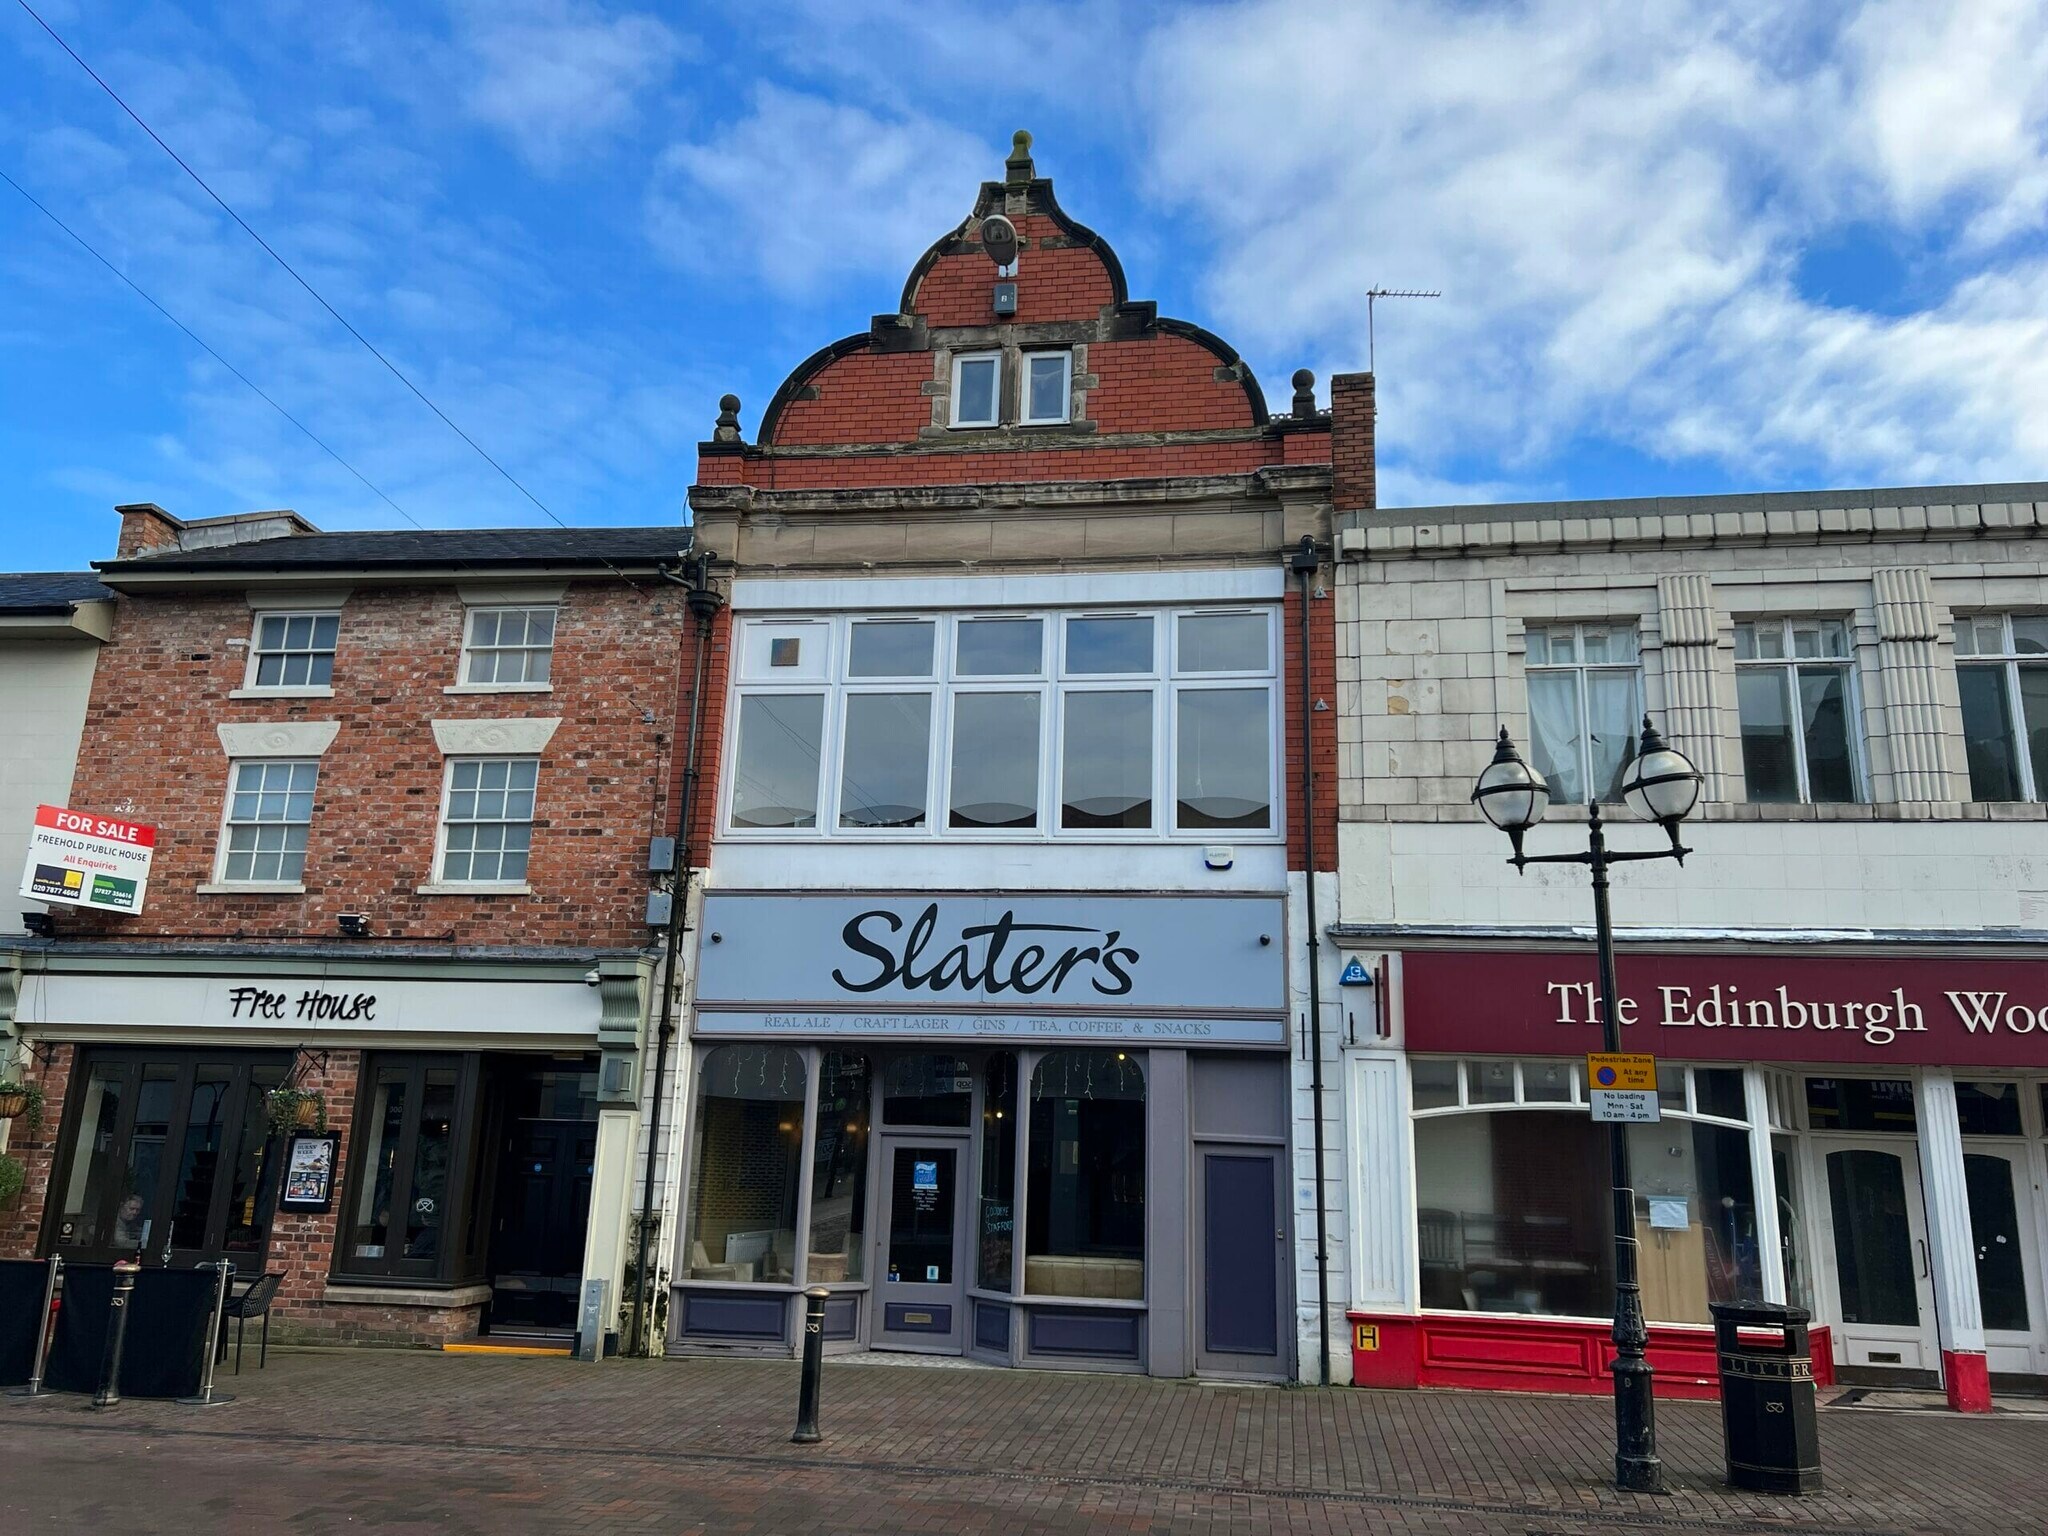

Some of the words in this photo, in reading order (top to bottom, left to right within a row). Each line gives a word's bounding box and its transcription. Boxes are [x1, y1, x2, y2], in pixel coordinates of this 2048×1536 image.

[56, 812, 92, 833] FOR
[96, 821, 139, 842] SALE
[37, 834, 84, 851] FREEHOLD
[85, 843, 117, 857] PUBLIC
[118, 850, 147, 862] HOUSE
[63, 854, 76, 863] All
[77, 857, 118, 871] Enquiries
[33, 884, 45, 893] 020
[831, 902, 1140, 996] Slater's
[229, 987, 287, 1019] Free
[296, 989, 377, 1021] House
[1657, 984, 1929, 1046] Edinburgh
[764, 1015, 800, 1028] REAL
[804, 1016, 831, 1028] ALE
[853, 1016, 900, 1029] CRAFT
[903, 1017, 949, 1030] LAGER
[972, 1018, 1005, 1031] GINS
[1068, 1020, 1123, 1033] COFFEE
[1133, 1022, 1144, 1034] &
[1153, 1021, 1211, 1035] SNACKS
[1590, 1055, 1631, 1063] Pedestrian
[1632, 1056, 1652, 1064] Zone
[1634, 1069, 1648, 1077] any
[1617, 1092, 1646, 1101] loading
[1630, 1102, 1644, 1110] Sat
[1360, 1326, 1376, 1348] H
[1730, 1359, 1810, 1376] LITTER
